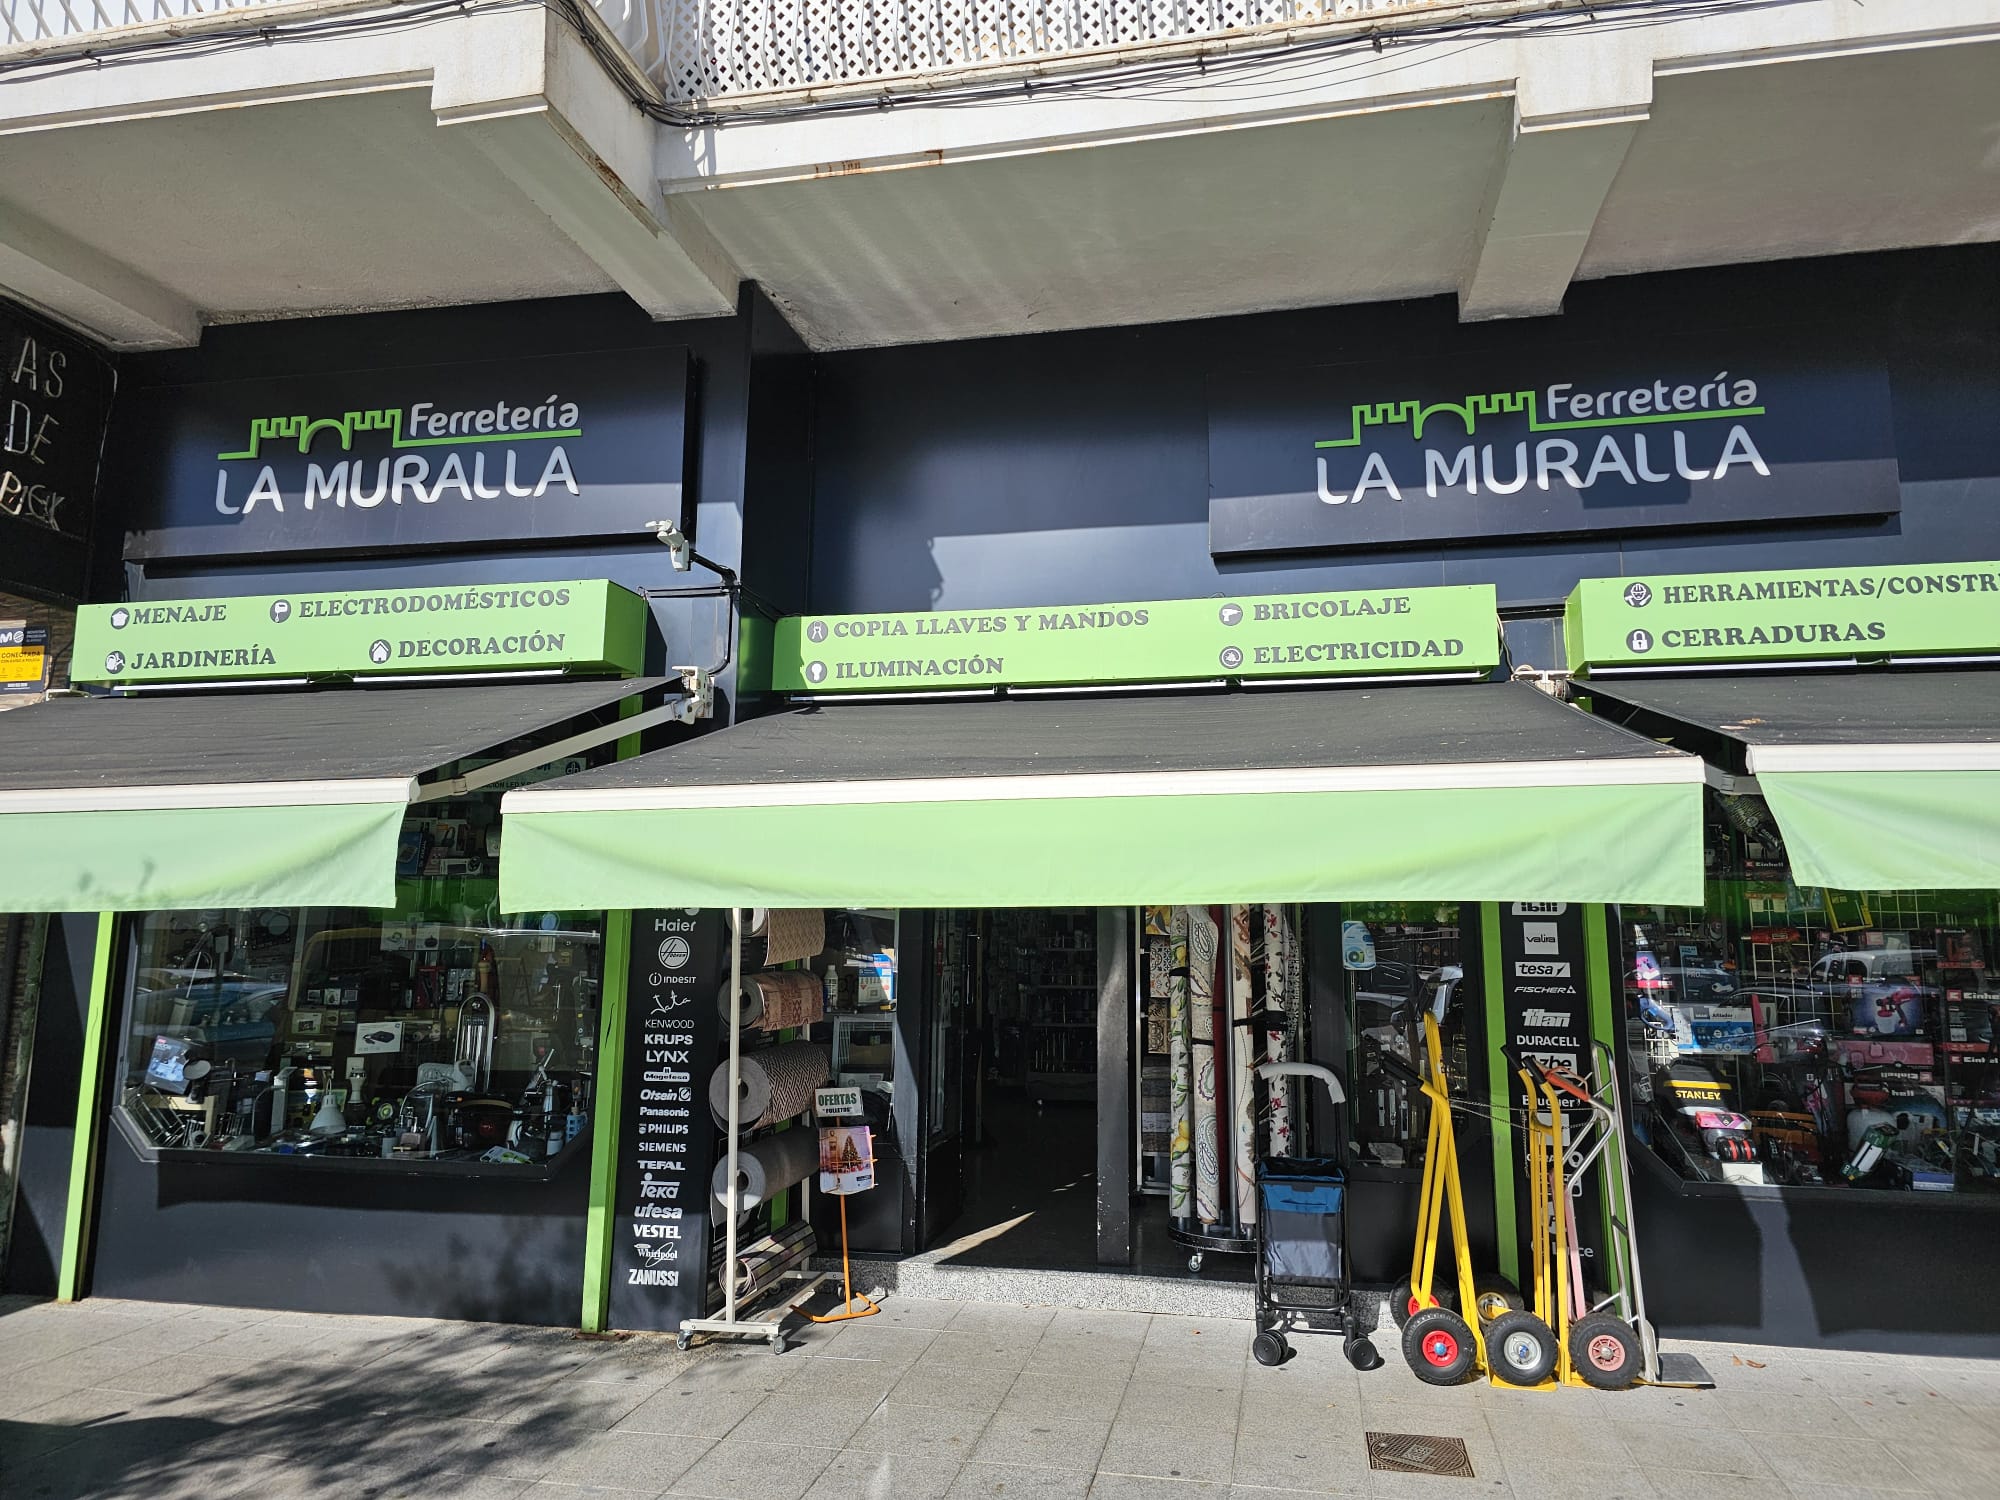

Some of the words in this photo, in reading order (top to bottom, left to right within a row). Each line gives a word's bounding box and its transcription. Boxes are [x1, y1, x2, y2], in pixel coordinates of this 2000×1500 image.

[1547, 371, 1757, 420] Ferretería
[409, 394, 579, 437] Ferretería
[1316, 452, 1402, 505] LA
[1425, 425, 1771, 498] MURALLA
[215, 466, 284, 515] LA
[304, 446, 580, 510] MURALLA
[1663, 573, 2000, 604] HERRAMIENTAS/CONSTR
[298, 588, 571, 619] ELECTRODOMÉSTICOS
[1253, 597, 1411, 621] BRICOLAJE
[132, 604, 227, 625] MENAJE
[833, 616, 908, 638] COPIA
[915, 615, 1008, 636] LLAVES
[1016, 615, 1034, 633] Y
[1038, 609, 1150, 632] MANDOS
[397, 630, 566, 659] DECORACIÓN
[1662, 622, 1886, 648] CERRADURAS
[130, 644, 277, 670] JARDINERÍA
[1253, 639, 1464, 664] ELECTRICIDAD
[835, 655, 1004, 679] ILUMINACIÓN
[654, 918, 697, 932] Haier
[1526, 934, 1556, 943] valira
[1519, 963, 1554, 976] tesa
[1514, 986, 1567, 994] FISCHER
[645, 1019, 695, 1029] KENWOOD
[1522, 1008, 1571, 1028] titan
[644, 1034, 694, 1045] KRUPS
[1516, 1035, 1581, 1047] DURACELL
[646, 1050, 689, 1063] LYNX
[818, 1093, 857, 1106] OFERTAS
[1675, 1089, 1721, 1100] STANLEY
[639, 1106, 690, 1117] Panasonic
[648, 1123, 689, 1134] PHILIPS
[638, 1142, 687, 1153] SIEMENS
[637, 1160, 686, 1171] TEFAL
[634, 1203, 683, 1219] ufesa
[633, 1223, 682, 1239] VESTEL
[634, 1243, 678, 1263] Whirlpool
[628, 1268, 679, 1287] ZANUSSI
